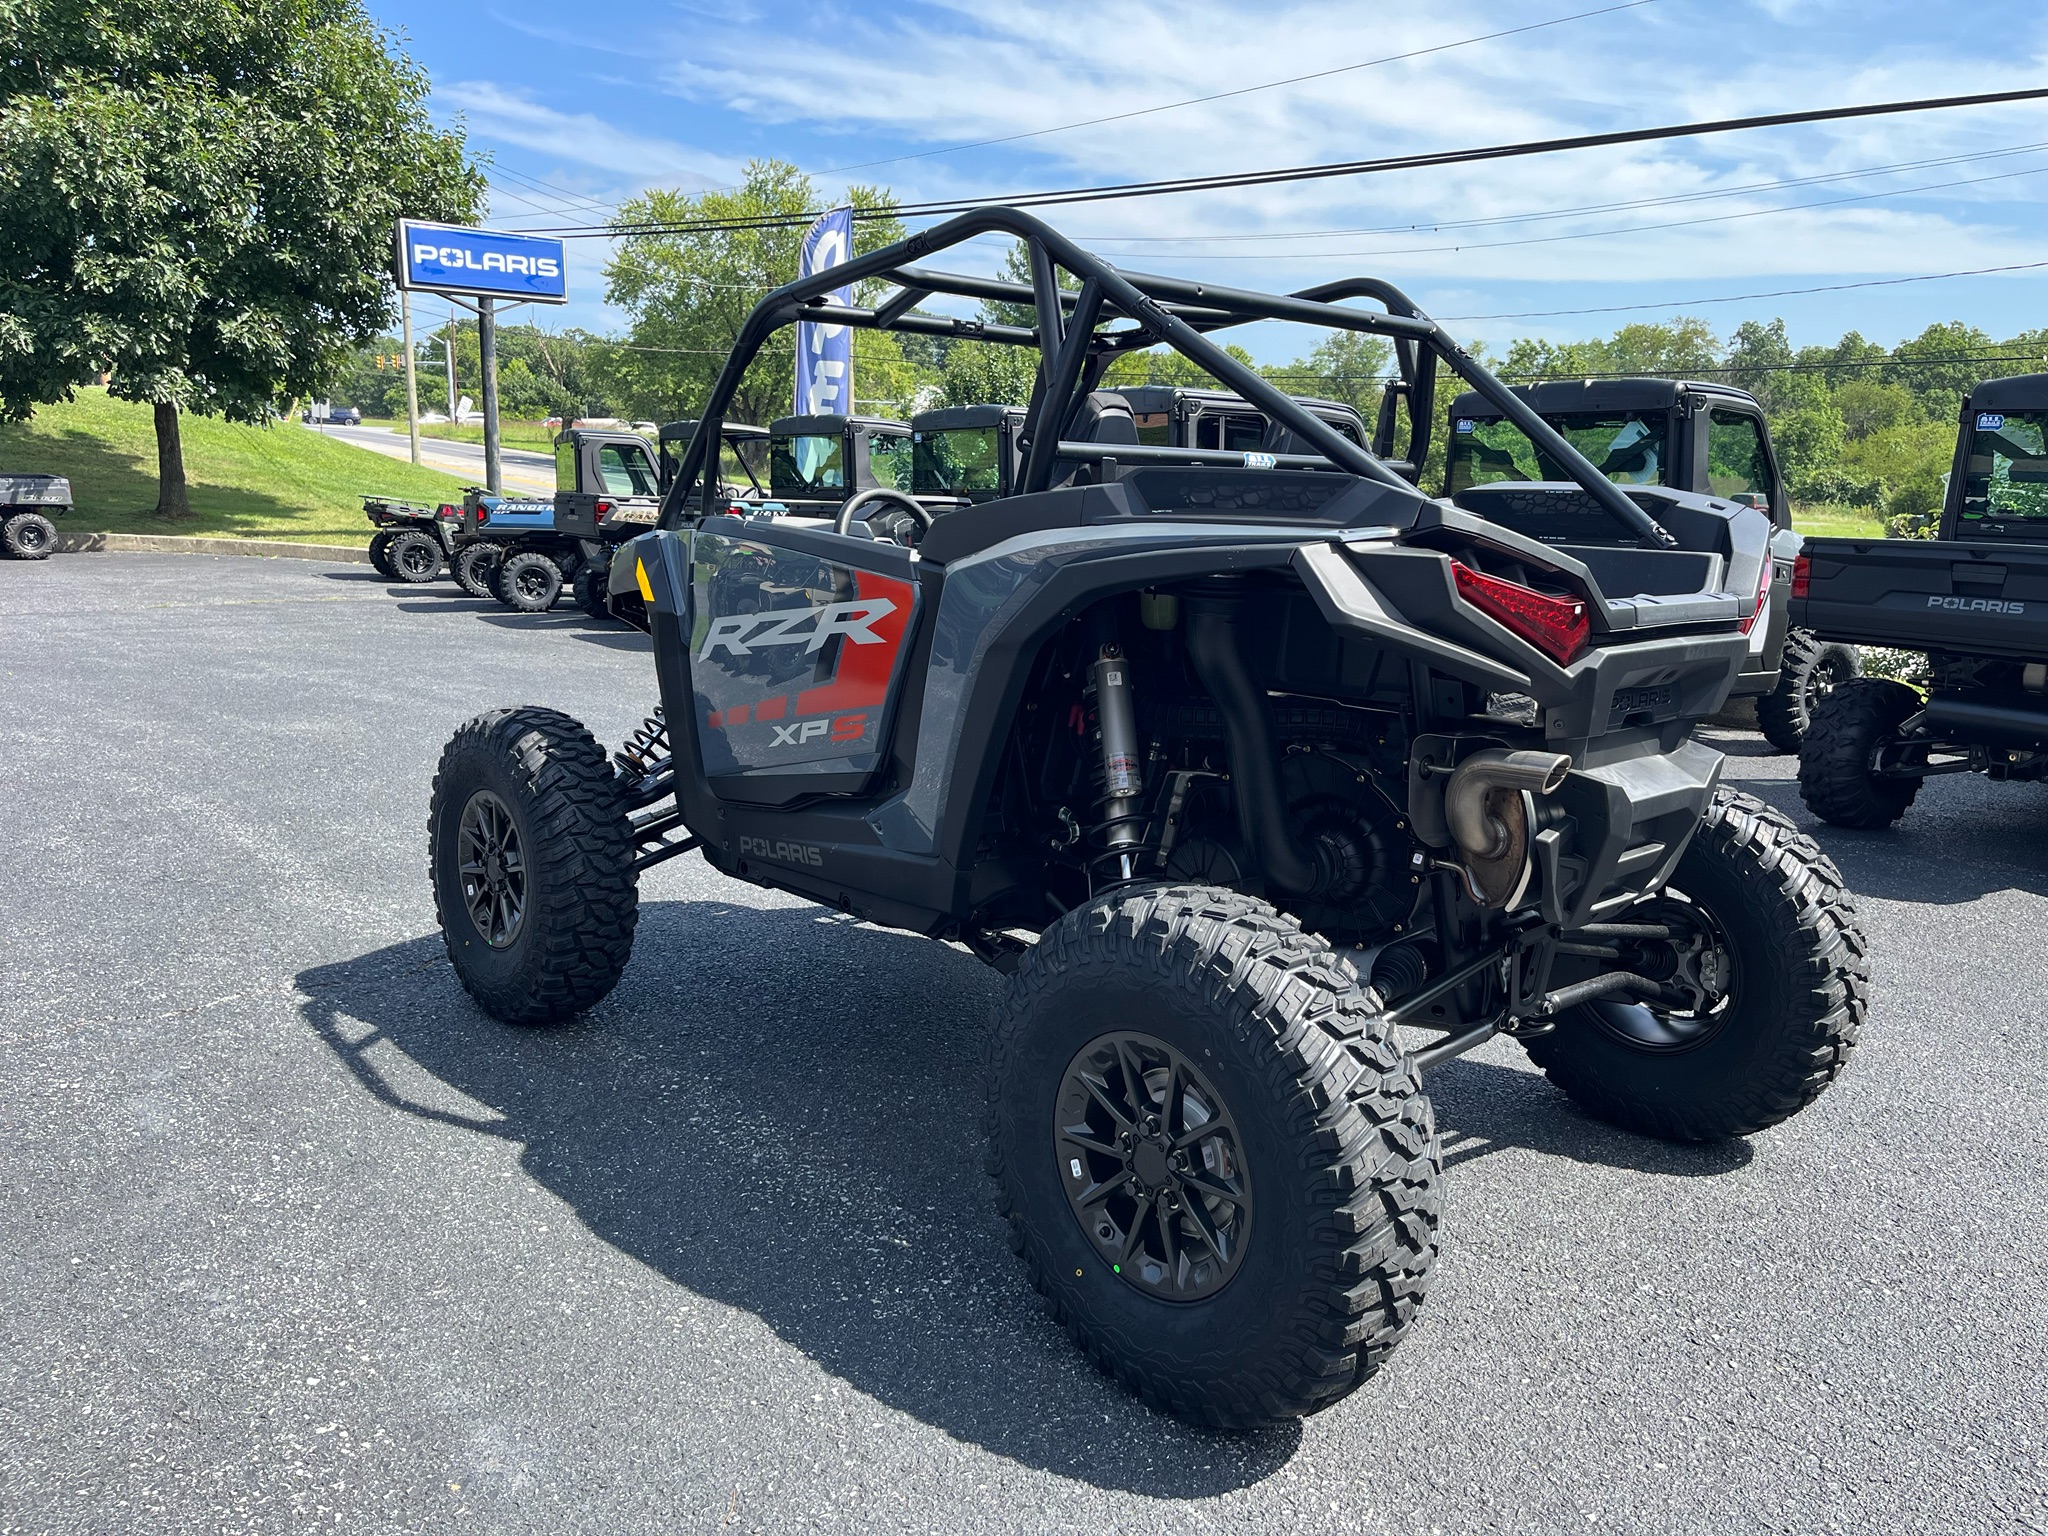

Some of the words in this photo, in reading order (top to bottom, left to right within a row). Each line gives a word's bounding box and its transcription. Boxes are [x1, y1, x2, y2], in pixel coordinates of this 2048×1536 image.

[413, 244, 559, 277] POLARIS
[1927, 596, 2025, 614] POLARIS
[697, 598, 898, 663] RZR
[739, 835, 823, 867] POLARIS
